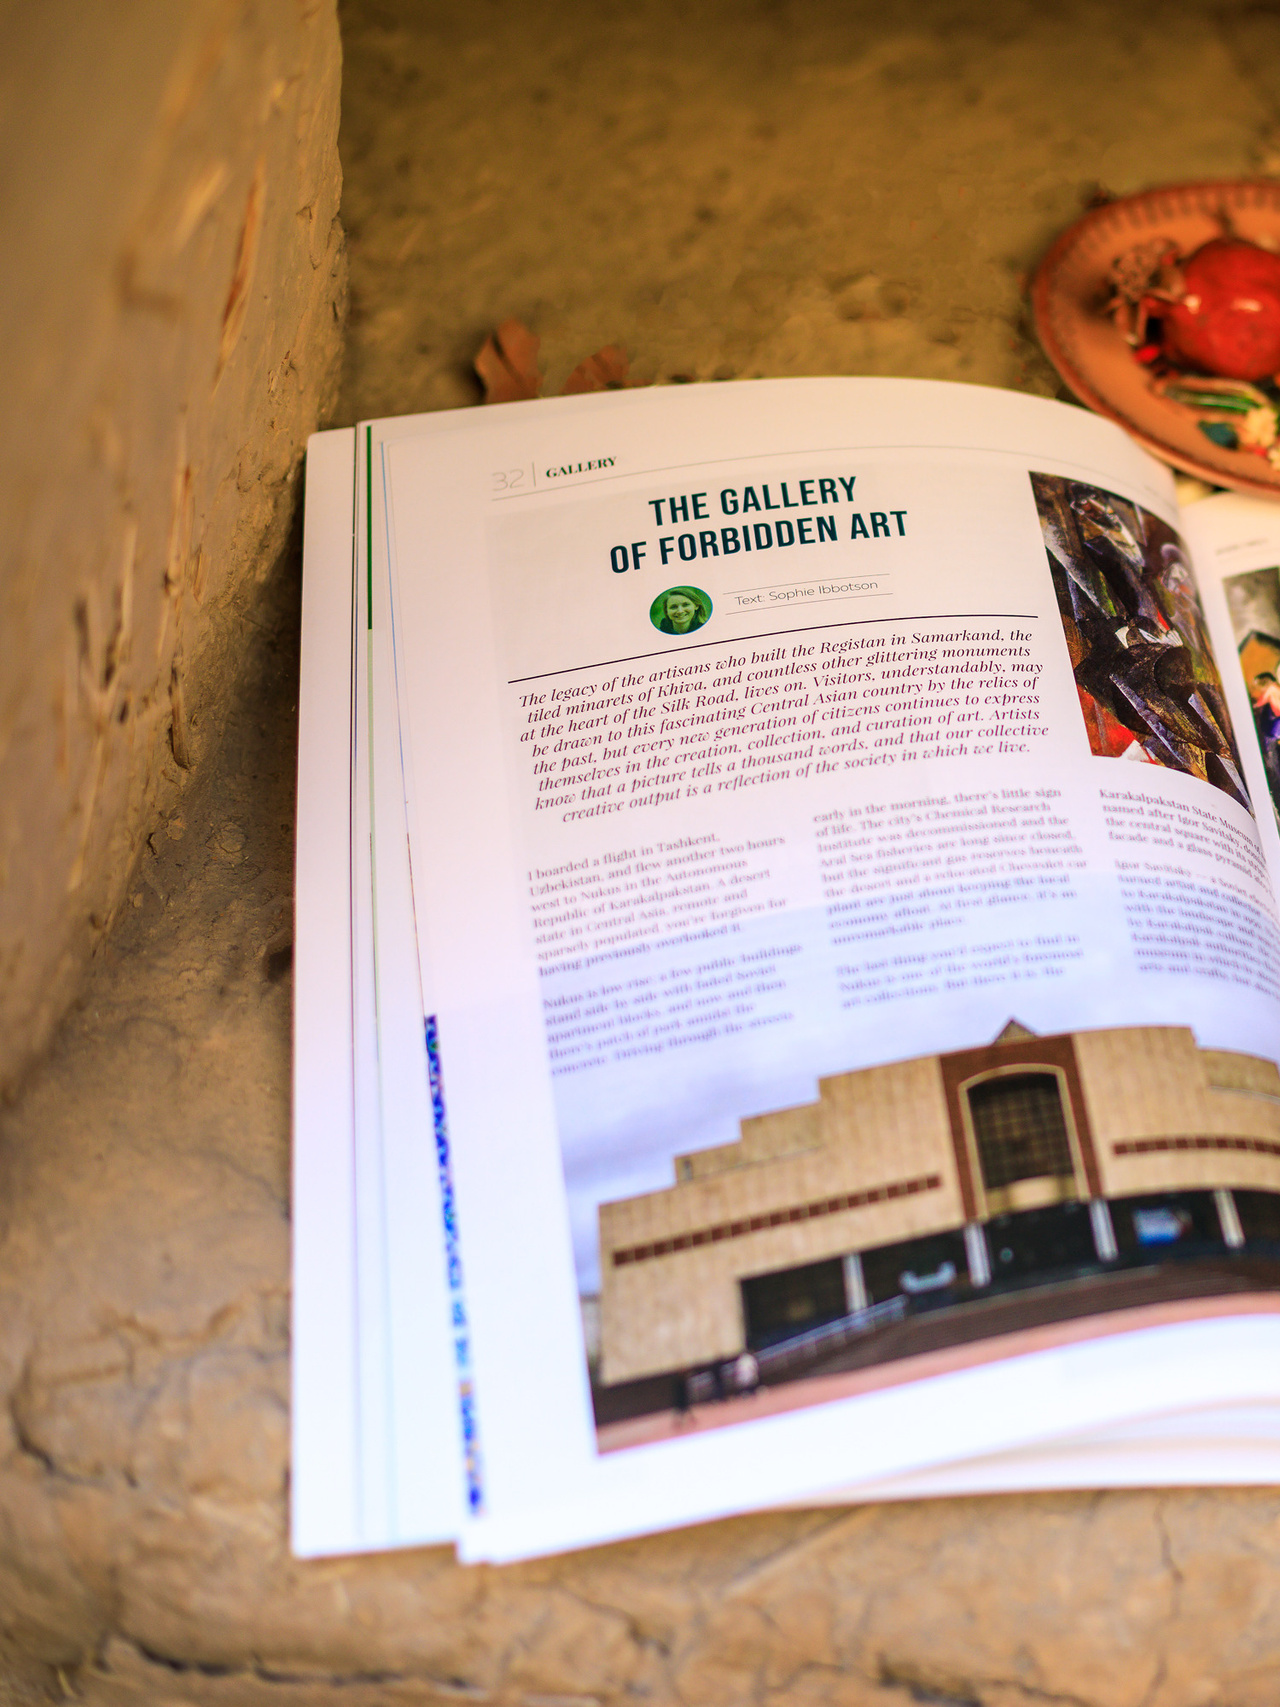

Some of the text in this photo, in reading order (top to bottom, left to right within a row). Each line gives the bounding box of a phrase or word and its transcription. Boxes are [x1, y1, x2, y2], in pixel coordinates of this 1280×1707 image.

[492, 457, 617, 491] 32 GALLERY
[648, 476, 857, 526] THE GALLERY
[609, 510, 908, 574] OF FORBIDDEN ART
[734, 580, 879, 607] Text: Sophie Ibbotson
[519, 692, 547, 707] The
[551, 684, 597, 702] legacy
[601, 676, 619, 692] of
[621, 673, 644, 688] the
[648, 662, 711, 682] artisans
[715, 655, 746, 670] who
[751, 647, 786, 664] built
[792, 644, 815, 657] the
[820, 638, 886, 656] Registan
[890, 633, 906, 646] in
[1010, 629, 1032, 641] the
[520, 728, 535, 742] at
[540, 723, 564, 738] the
[568, 714, 608, 732] heart
[613, 708, 631, 724] of
[632, 705, 656, 719] the
[660, 697, 690, 714] Silk
[744, 685, 779, 699] lives
[1010, 663, 1043, 677] may
[527, 704, 561, 723] tiled
[566, 693, 633, 715] minarets
[637, 686, 655, 702] of
[712, 670, 742, 687] and
[746, 662, 817, 681] countless
[821, 655, 863, 670] other
[865, 648, 938, 667] glittering
[941, 646, 1030, 658] monuments
[532, 673, 1039, 757] be drawn to this fascinating Central Asian country by the relics of
[533, 760, 557, 775] the
[602, 745, 627, 760] but
[632, 738, 674, 754] every
[680, 731, 709, 745] new
[713, 716, 796, 741] generation
[802, 709, 819, 725] of
[821, 704, 880, 721] citizens
[885, 696, 960, 712] continues
[965, 694, 979, 705] to
[984, 694, 1040, 706] express
[538, 766, 621, 791] themselves
[625, 761, 640, 773] in
[646, 755, 670, 769] the
[831, 720, 861, 736] and
[866, 714, 932, 731] curation
[937, 710, 955, 725] of
[989, 708, 1040, 720] Artists
[535, 793, 576, 810] know
[581, 783, 611, 800] that
[616, 783, 626, 793] a
[631, 771, 686, 793] picture
[691, 761, 722, 778] tells
[726, 761, 736, 771] a
[741, 744, 814, 769] thousand
[874, 732, 904, 747] and
[909, 730, 940, 743] that
[945, 729, 973, 740] our
[977, 724, 1049, 737] collective
[562, 801, 624, 822] creative
[629, 788, 680, 808] output
[686, 784, 698, 797] is
[703, 784, 712, 794] a
[718, 769, 790, 791] reflection
[795, 762, 813, 778] of
[815, 760, 839, 774] the
[844, 753, 897, 769] society
[902, 749, 917, 761] in
[922, 743, 967, 759] which
[973, 744, 994, 754] we
